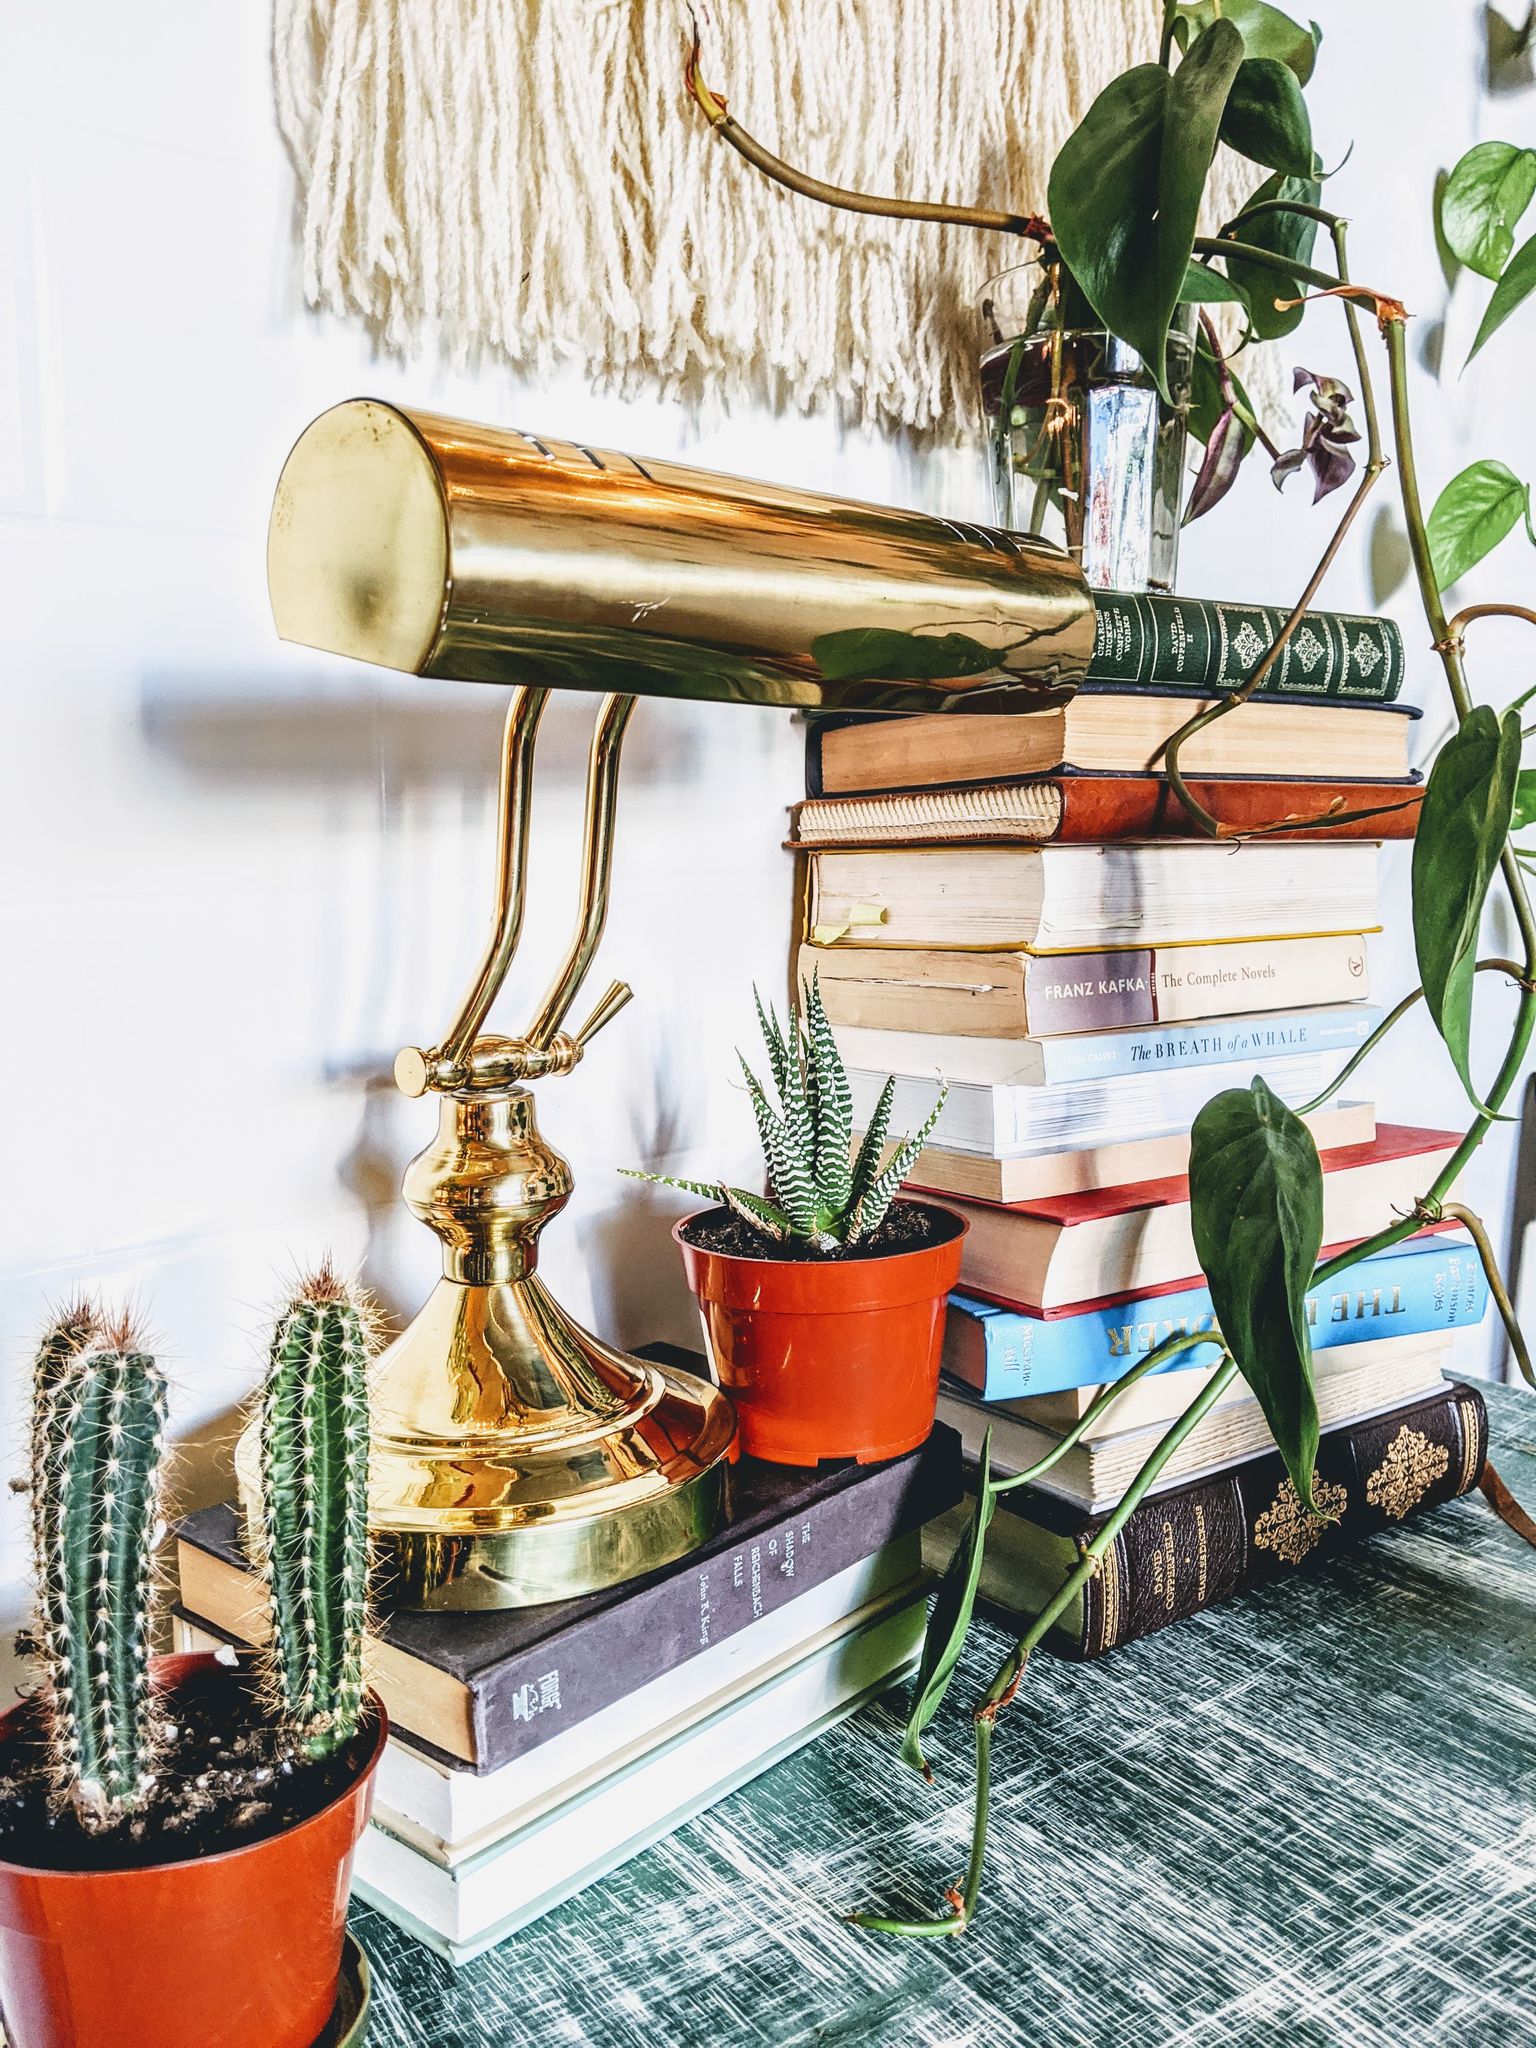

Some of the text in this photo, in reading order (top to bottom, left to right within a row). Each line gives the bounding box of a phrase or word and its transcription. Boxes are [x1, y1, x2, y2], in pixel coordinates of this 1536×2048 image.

[1095, 609, 1104, 656] CHARLES
[1103, 611, 1112, 657] DICKENS
[1113, 607, 1123, 661] COMPLETE
[1123, 615, 1132, 653] WORKS
[1170, 622, 1178, 654] DAVID
[1174, 606, 1186, 672] COPPERFIELD
[1045, 977, 1145, 1000] FRANZ KAFKA
[1162, 965, 1276, 988] The Complete Novels
[1131, 1045, 1151, 1061] The
[1156, 1037, 1222, 1058] BREATH
[1228, 1035, 1240, 1052] of
[1241, 1039, 1249, 1049] a
[1252, 1028, 1307, 1046] WHALE
[1331, 1286, 1406, 1322] THE
[769, 1539, 778, 1556] OF
[781, 1530, 795, 1577] SHADOW
[802, 1521, 811, 1545] THE
[1195, 1505, 1207, 1601] CHARLES DICKENS
[733, 1555, 743, 1587] FALLS
[750, 1546, 763, 1619] REICHENBACH
[1154, 1549, 1163, 1595] DAVID
[1163, 1521, 1176, 1610] COPPERFIELD
[699, 1574, 711, 1645] John R. King
[537, 1669, 562, 1713] FORGE
